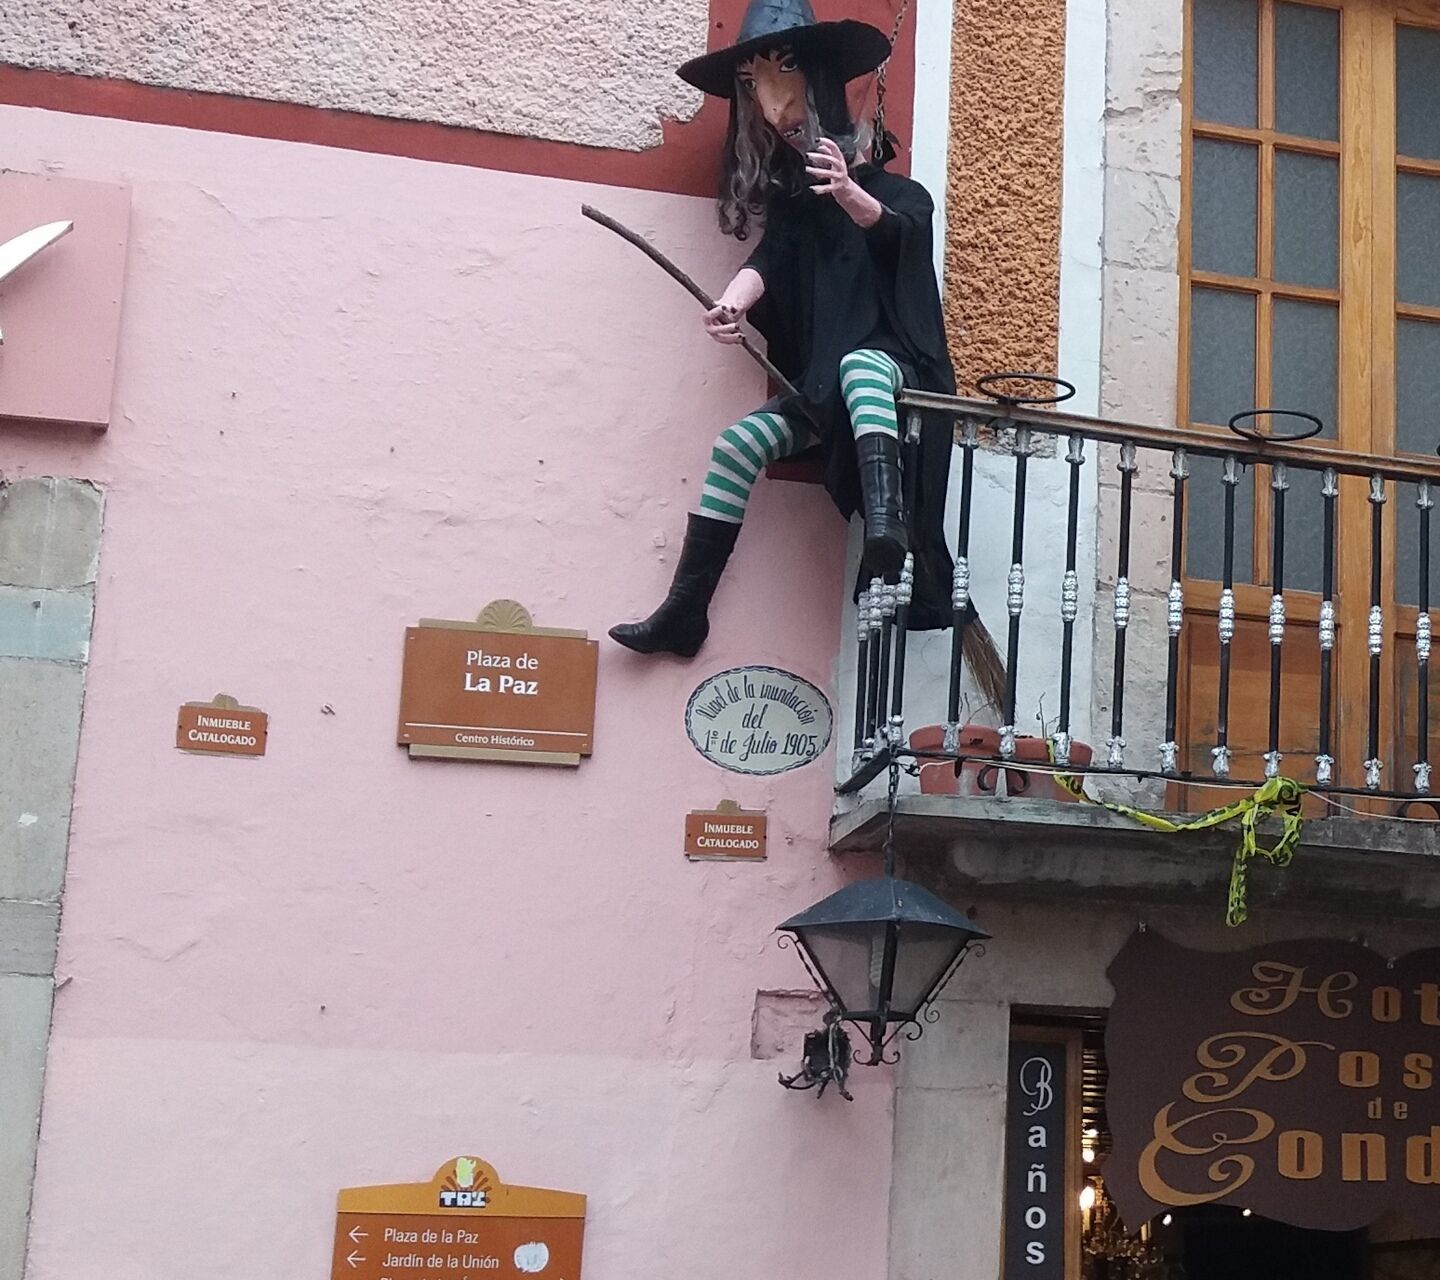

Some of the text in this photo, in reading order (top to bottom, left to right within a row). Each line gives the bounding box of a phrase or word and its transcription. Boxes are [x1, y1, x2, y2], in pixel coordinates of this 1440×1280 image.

[466, 650, 539, 670] Plaza de
[464, 672, 539, 695] La Paz
[695, 674, 819, 725] Nivel de la inundación
[197, 715, 252, 731] INMUEBLE
[741, 703, 769, 729] del
[188, 729, 257, 746] CATALOGADO
[455, 732, 535, 747] Centro Histórico
[720, 730, 738, 754] de
[704, 822, 754, 834] INMUEBLE
[697, 836, 759, 849] CATALOGADO
[1367, 1097, 1409, 1120] de
[1019, 1056, 1053, 1265] Baños
[384, 1227, 479, 1244] Plaza de la Paz
[382, 1253, 500, 1269] Jardín de la Unión
